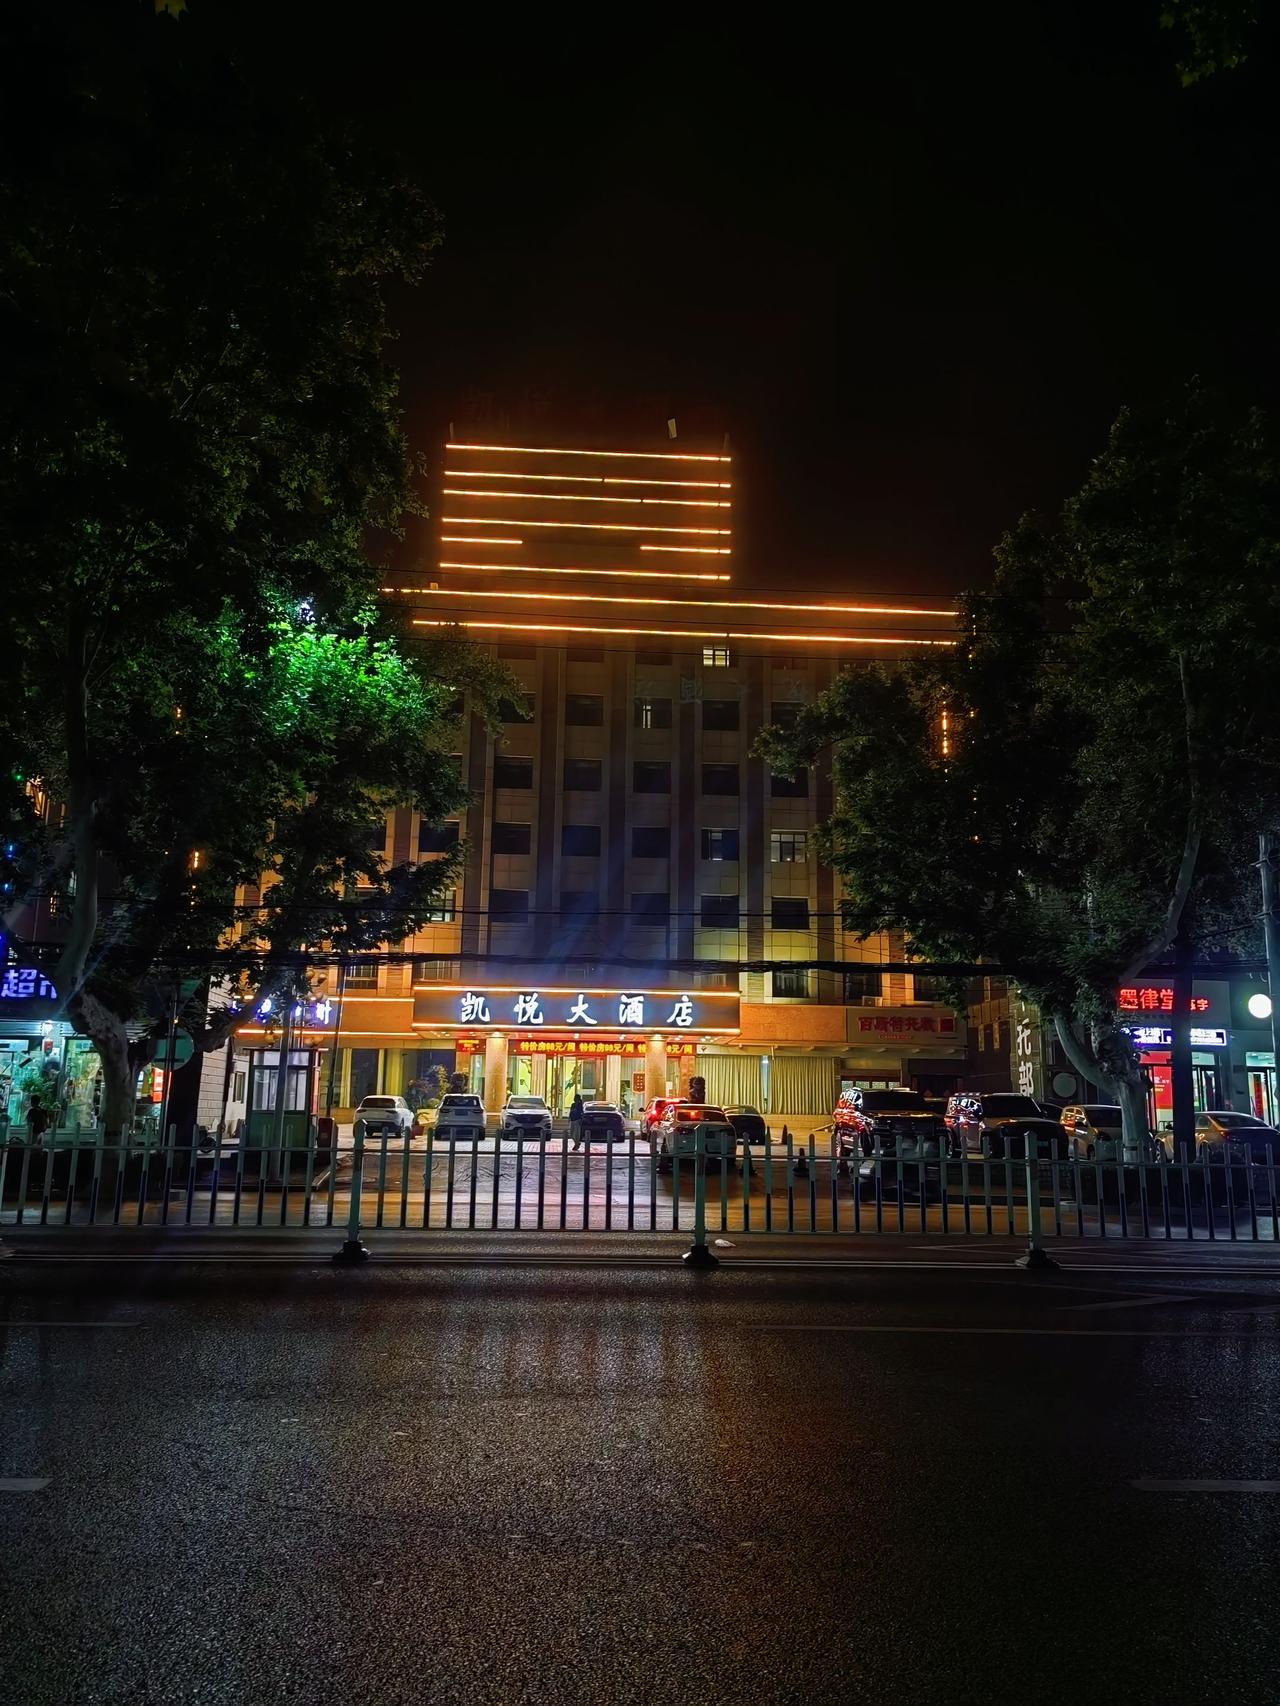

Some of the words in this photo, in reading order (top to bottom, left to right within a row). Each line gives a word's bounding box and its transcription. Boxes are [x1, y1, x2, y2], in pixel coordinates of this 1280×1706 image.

[460, 991, 696, 1027] 凯悦大酒店
[1120, 988, 1174, 1010] 墨律堂
